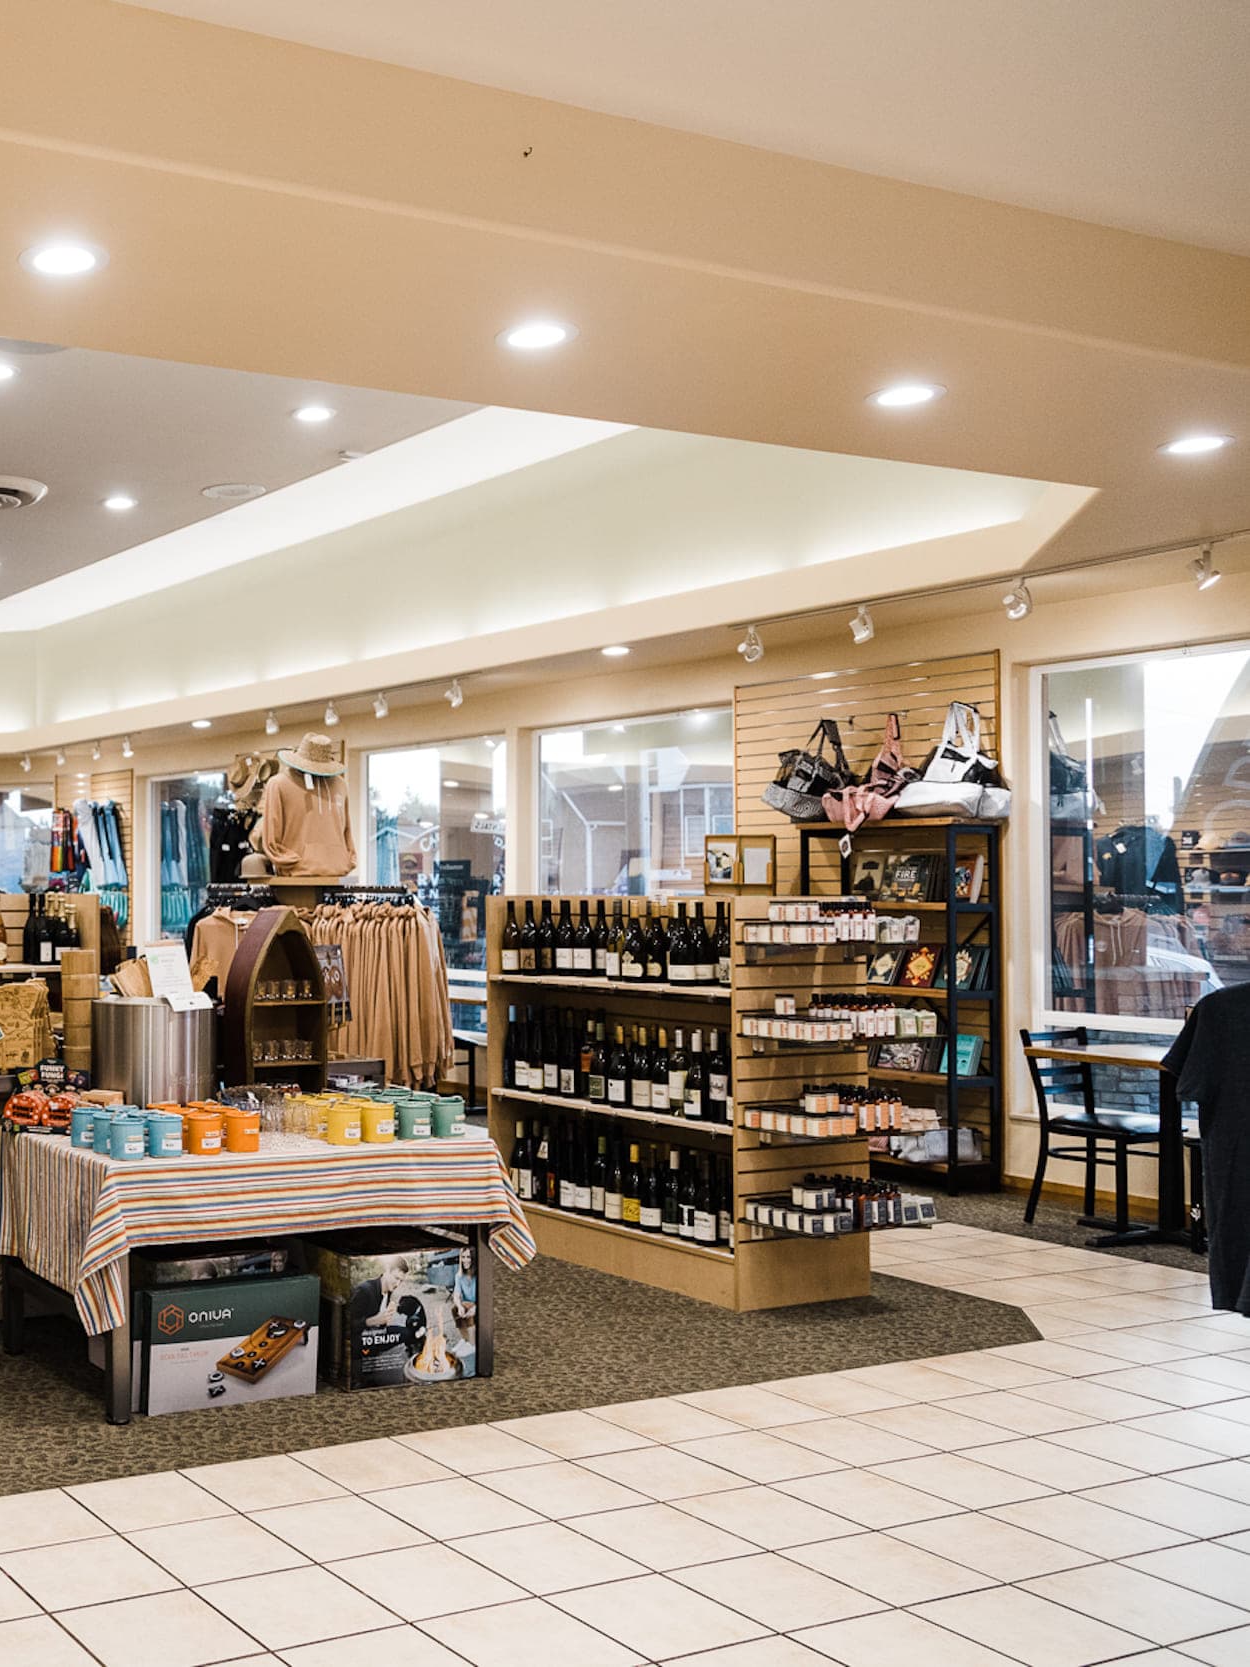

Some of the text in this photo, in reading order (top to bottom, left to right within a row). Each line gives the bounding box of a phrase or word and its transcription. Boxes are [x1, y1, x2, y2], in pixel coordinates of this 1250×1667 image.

[894, 870, 918, 880] FIRE
[188, 1308, 232, 1324] ONIVA
[361, 1333, 401, 1346] TO ENJOY
